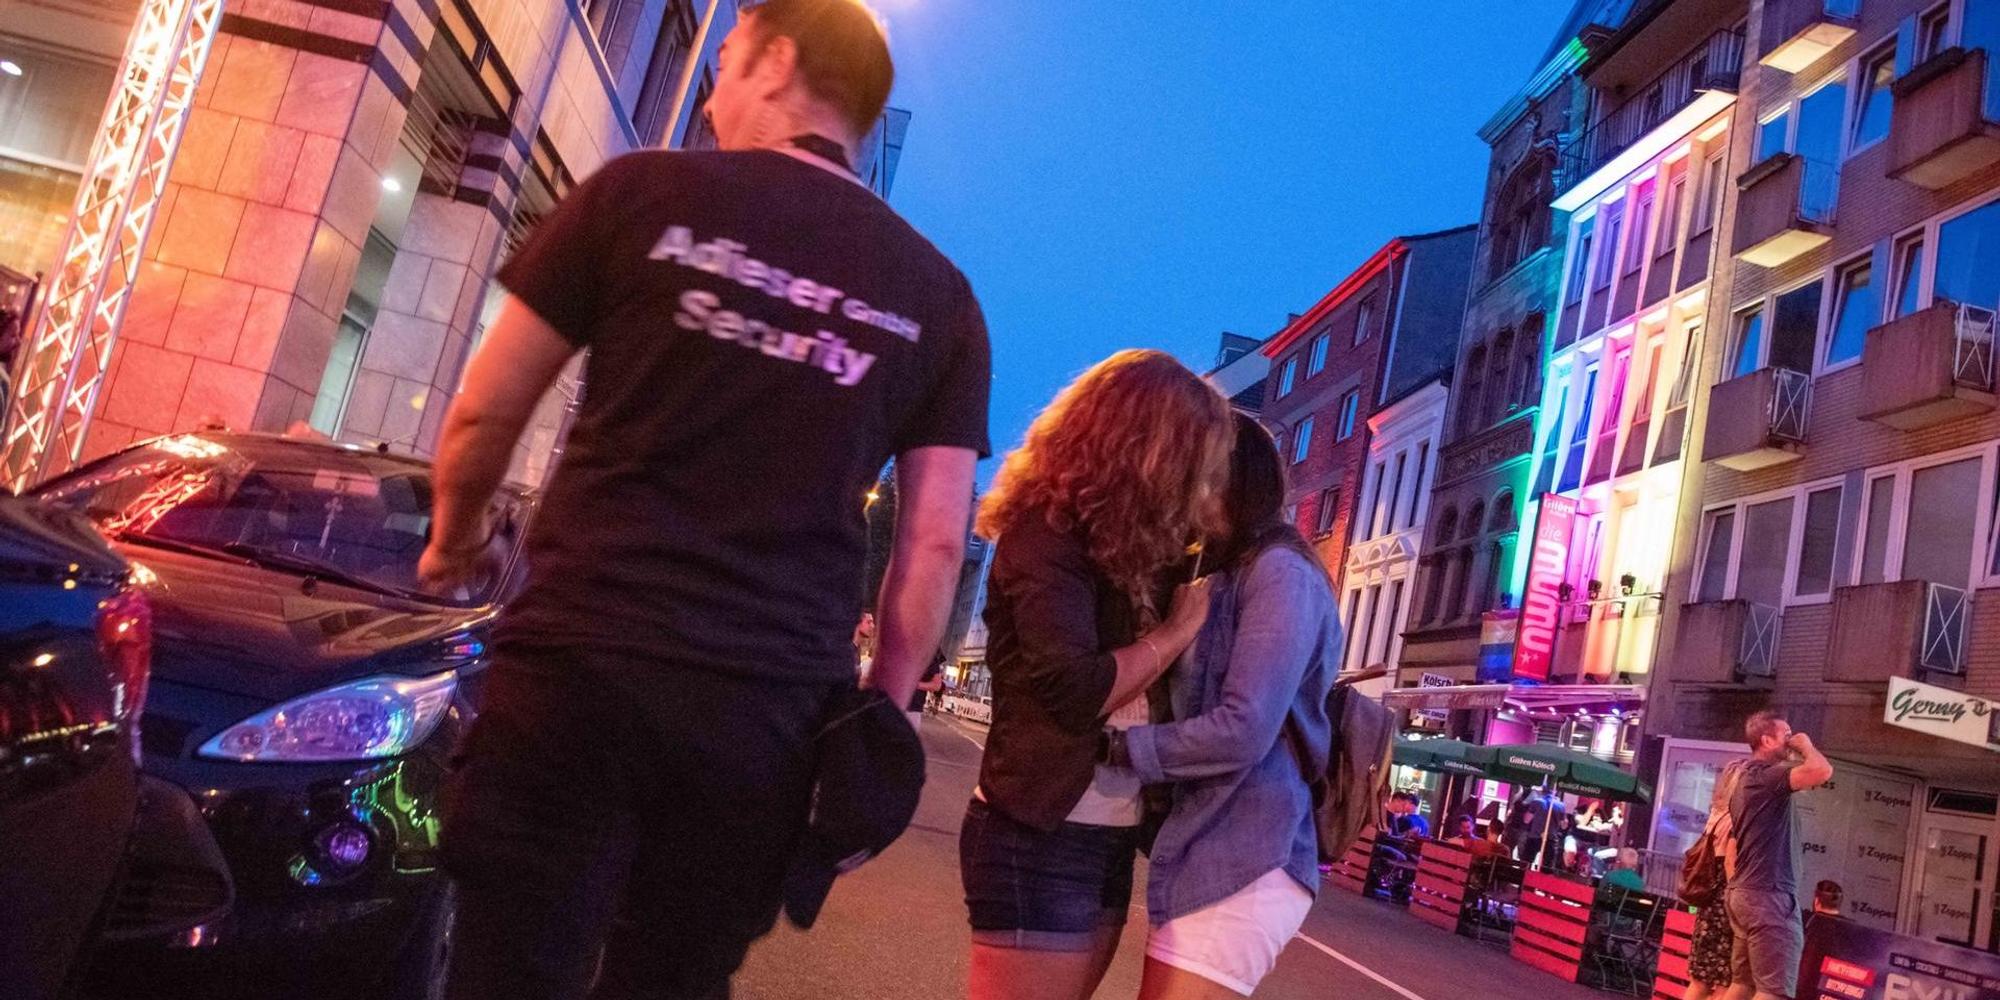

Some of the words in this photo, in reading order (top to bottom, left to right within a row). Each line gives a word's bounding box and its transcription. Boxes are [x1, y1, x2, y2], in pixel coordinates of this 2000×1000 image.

[674, 289, 876, 386] Security
[1540, 521, 1562, 539] die
[1522, 540, 1567, 653] mumu
